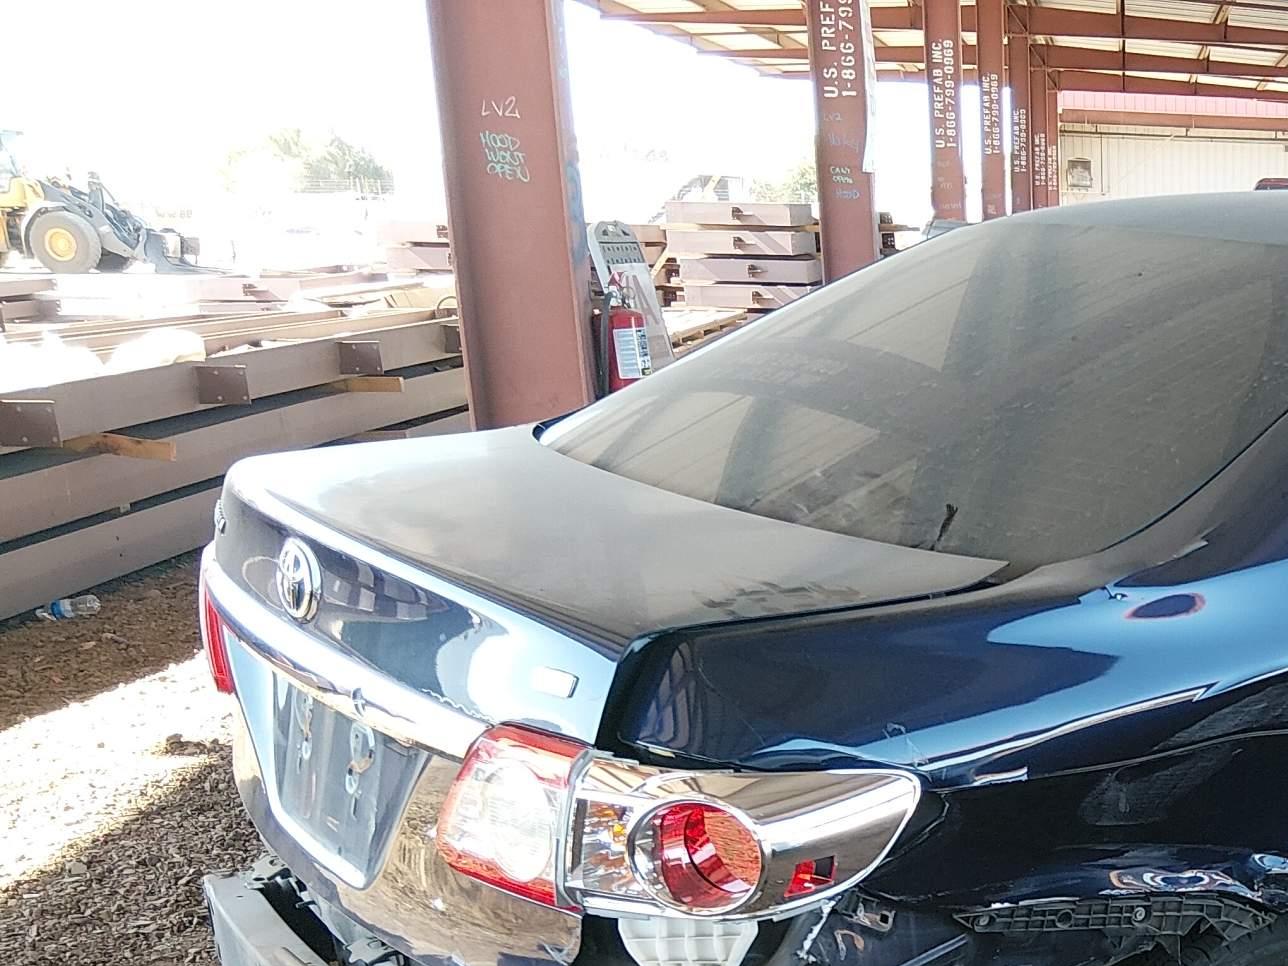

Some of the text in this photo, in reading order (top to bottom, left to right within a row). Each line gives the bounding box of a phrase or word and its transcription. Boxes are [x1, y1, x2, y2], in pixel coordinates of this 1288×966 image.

[931, 38, 943, 63] INC.
[823, 62, 839, 98] U.S.
[932, 68, 944, 118] PREFAB
[982, 95, 991, 132] PREFAB
[934, 123, 946, 148] U.S.
